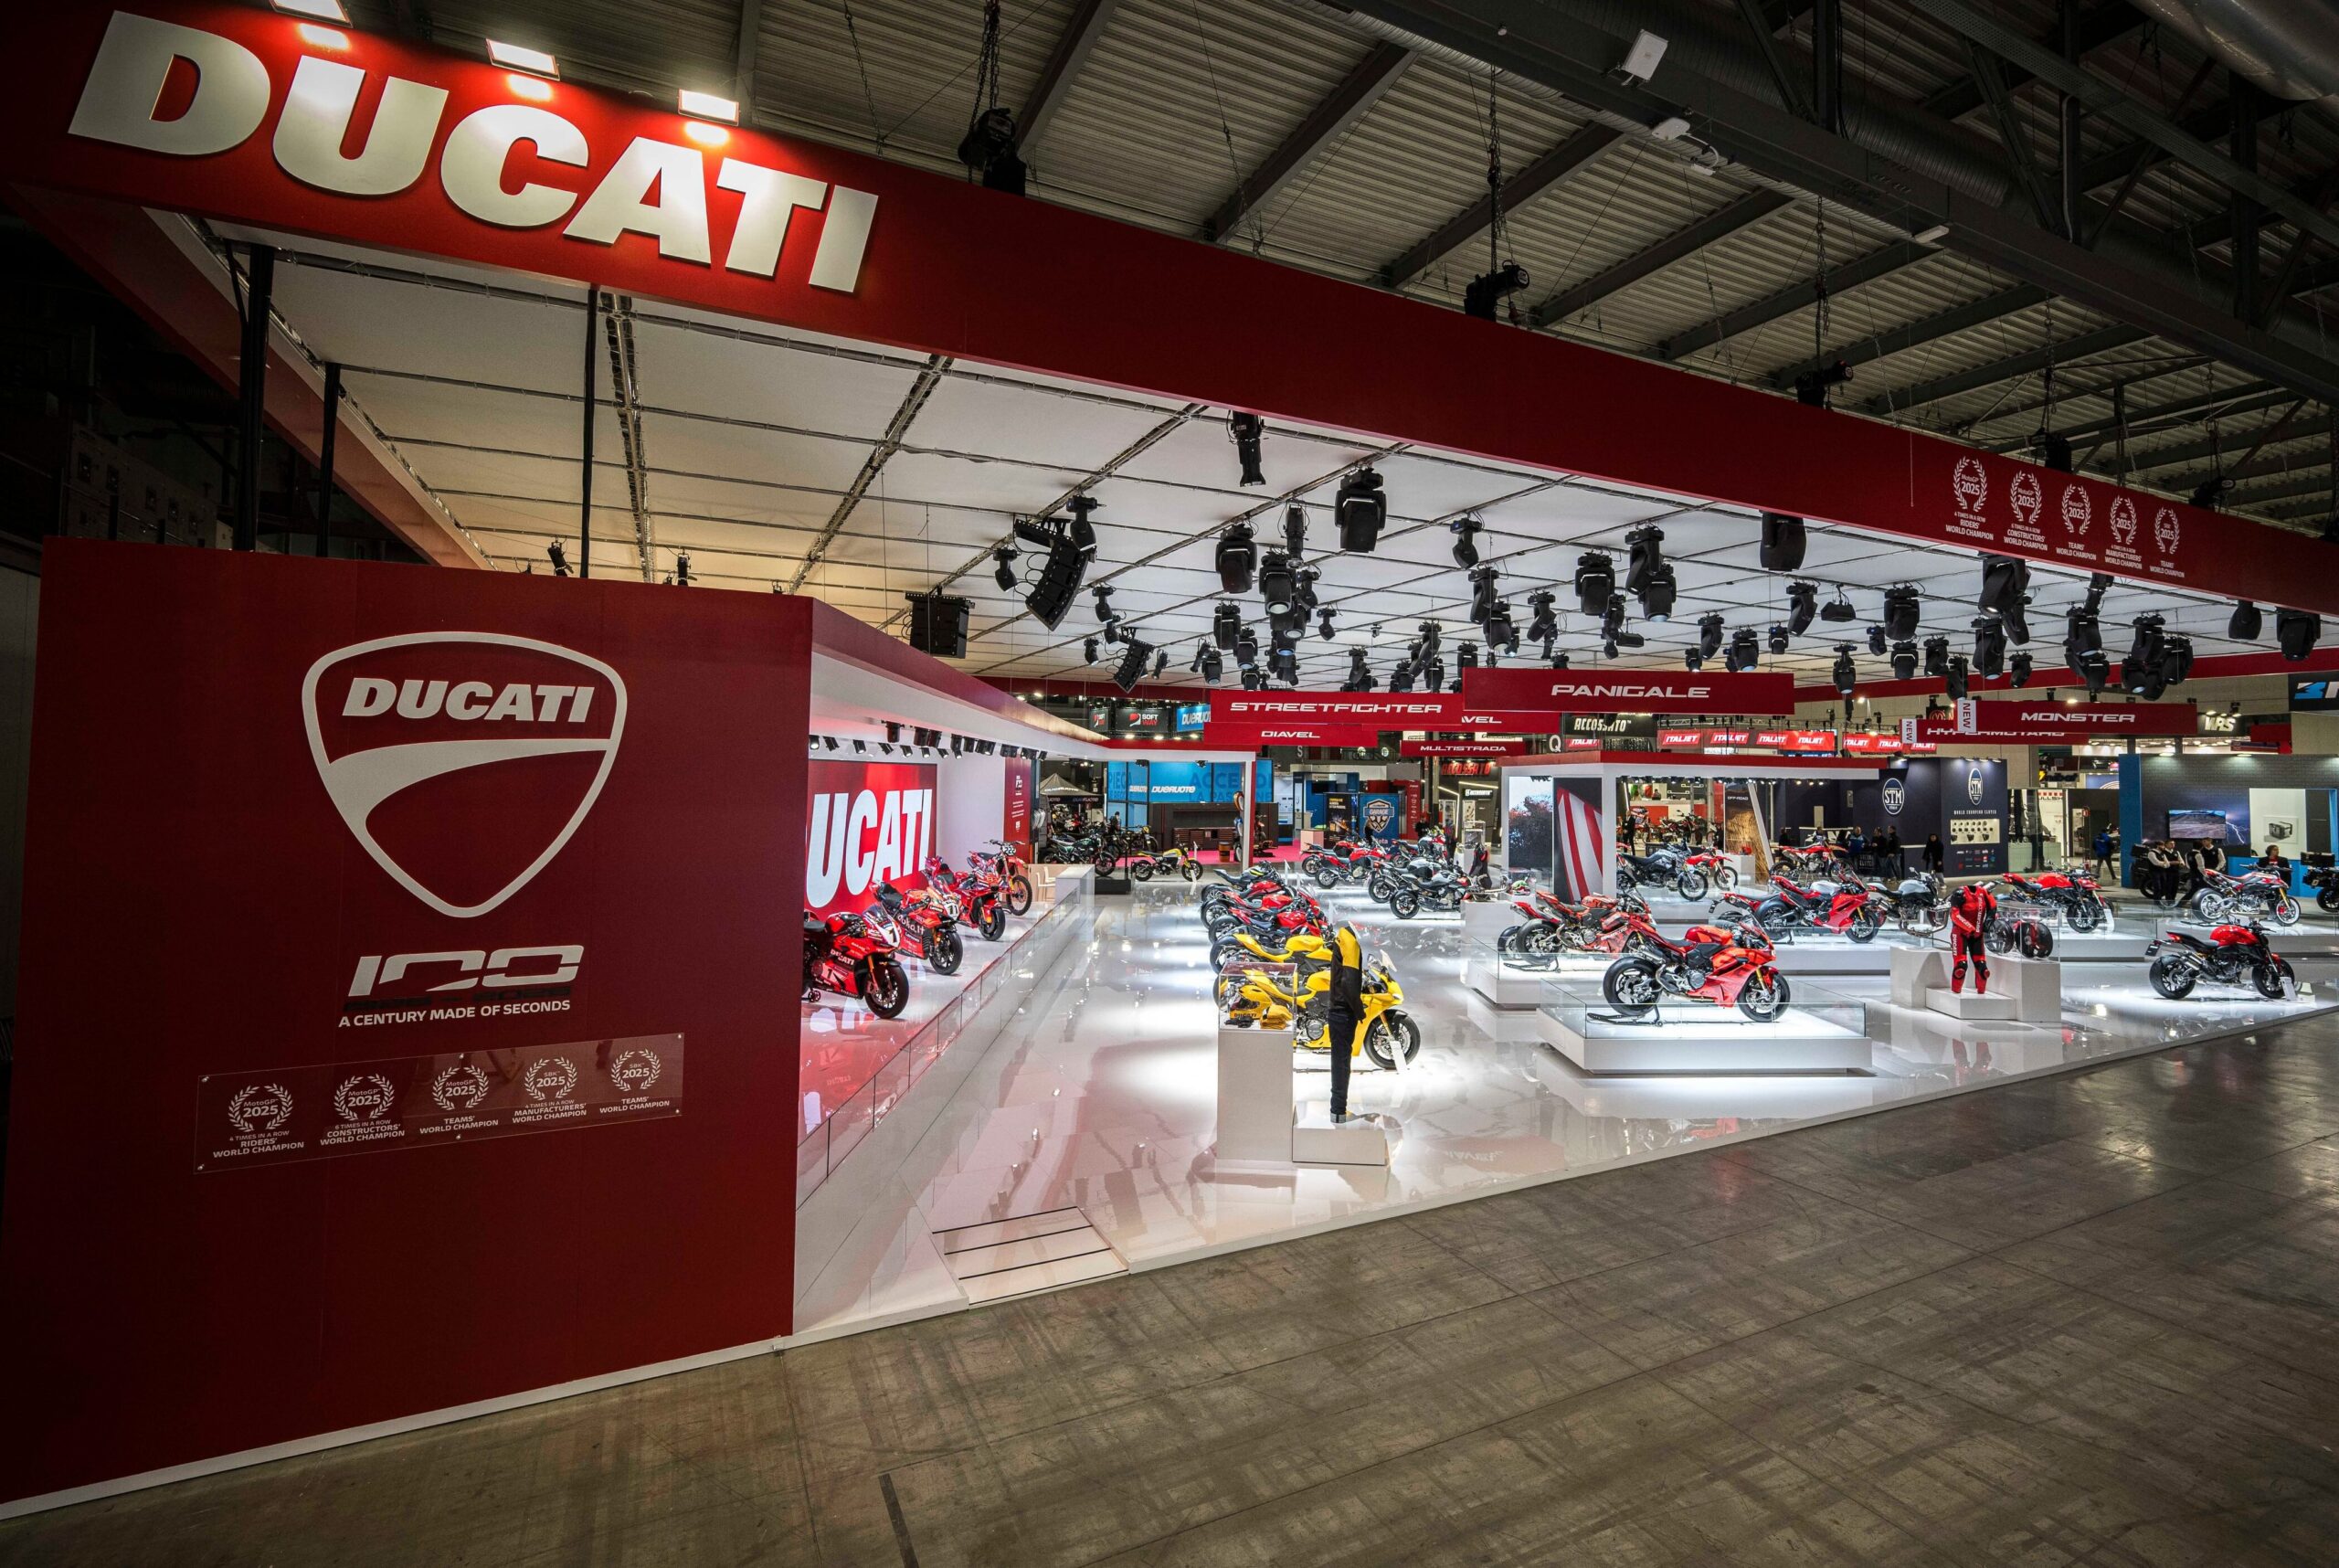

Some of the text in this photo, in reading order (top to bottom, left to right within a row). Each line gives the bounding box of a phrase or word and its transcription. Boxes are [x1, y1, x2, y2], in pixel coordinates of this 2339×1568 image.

[68, 9, 880, 294] DUCATI
[1961, 482, 1980, 495] 2025
[2017, 494, 2036, 508] 2025
[2068, 507, 2085, 519] 2025
[2116, 517, 2132, 530] 2025
[1945, 524, 1994, 540] WORLD CHAMPION
[2161, 528, 2175, 540] 2025
[2004, 536, 2048, 551] WORLD CHAMPION
[2056, 547, 2097, 560] WORLD CHAMPION
[1551, 684, 1710, 698] PANIGALE
[342, 677, 595, 723] DUCATI
[1230, 702, 1442, 713] STREETFIGHTER
[1462, 715, 1502, 724] VEL
[1963, 703, 1971, 728] NEW
[2021, 713, 2135, 723] MONSTER
[2205, 715, 2237, 732] WRS
[1261, 730, 1320, 738] DIAVEL
[1713, 734, 1747, 742] ITALJET
[1549, 734, 1561, 753] Q
[1297, 746, 1303, 758] S
[1971, 780, 1982, 795] STM
[1884, 789, 1902, 804] STM
[805, 789, 933, 908] UCATI
[889, 927, 897, 943] 1
[830, 948, 854, 966] DUCATI
[827, 969, 832, 979] 1
[338, 1000, 571, 1028] A CENTURY MADE OF SECONDS
[622, 1068, 650, 1078] 2025
[536, 1076, 566, 1087] 2025
[445, 1086, 476, 1097] 2025
[347, 1095, 381, 1107] 2025
[599, 1100, 670, 1113] WORLD CHAMPION
[243, 1105, 279, 1118] 2025
[512, 1110, 587, 1124] WORLD CHAMPION
[514, 1103, 587, 1117] MANUFACTURERS'
[327, 1123, 401, 1138] CONSTRUCTORS'
[419, 1119, 499, 1134] WORLD CHAMPION
[240, 1138, 278, 1148] RIDERS'
[320, 1130, 405, 1146] WORLD CHAMPION
[213, 1141, 304, 1159] WORLD CHAMPION
